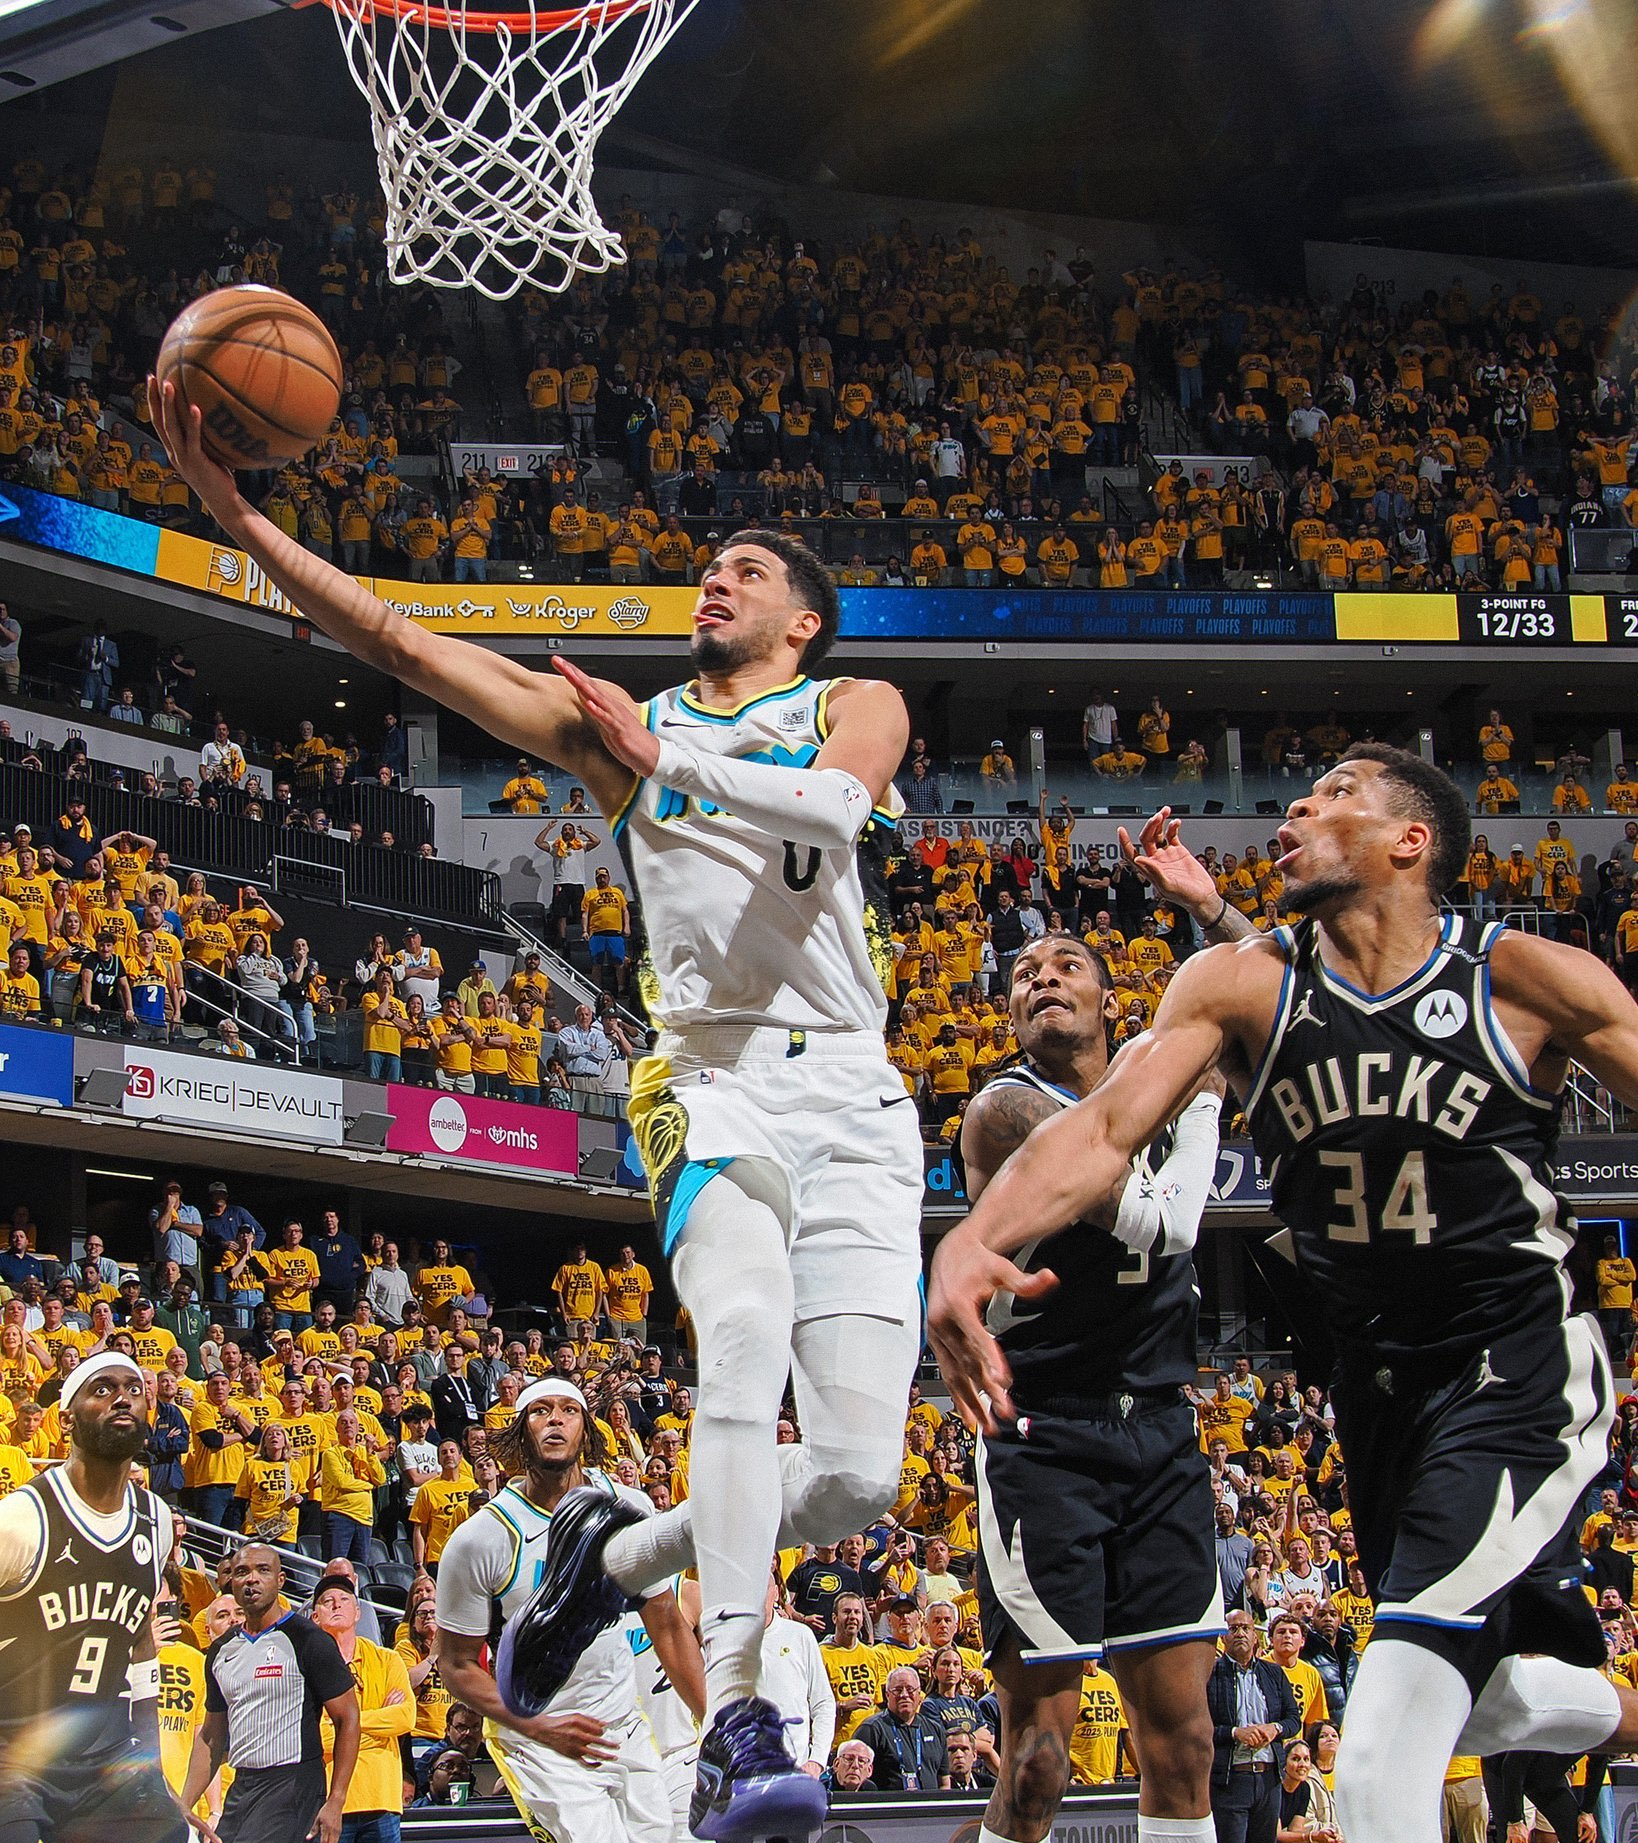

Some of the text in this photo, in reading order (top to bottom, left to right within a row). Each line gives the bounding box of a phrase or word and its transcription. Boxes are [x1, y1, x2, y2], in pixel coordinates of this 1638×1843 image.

[462, 452, 486, 471] 211
[501, 457, 517, 468] EXIT
[1579, 511, 1598, 524] 77
[384, 599, 455, 618] KeyBank
[1167, 599, 1210, 615] PLAYOFFS
[1223, 599, 1267, 615] PLAYOFFS
[1481, 599, 1547, 610] 3-POINT FG
[534, 595, 597, 629] Kroger
[608, 599, 650, 626] Starry
[1195, 619, 1240, 634] PLAYOFFS
[1252, 619, 1296, 634] PLAYOFFS
[1476, 612, 1555, 638] 12/33
[66, 727, 82, 740] 107
[114, 861, 138, 869] CERS
[20, 886, 41, 894] YES
[18, 894, 44, 903] CERS
[104, 917, 124, 926] YES
[101, 925, 127, 936] CERS
[206, 929, 224, 938] YES
[8, 986, 26, 997] YES
[147, 985, 158, 1002] 7
[520, 1036, 537, 1044] YES
[1272, 1053, 1492, 1142] BUCKS
[507, 1127, 538, 1150] mhs
[1574, 1161, 1638, 1183] Sports
[1319, 1150, 1437, 1245] 34
[286, 1259, 306, 1268] YES
[283, 1268, 309, 1277] CERS
[432, 1274, 453, 1282] YES
[572, 1273, 590, 1281] YES
[430, 1282, 457, 1290] CERS
[570, 1281, 593, 1289] CERS
[621, 1277, 638, 1285] YES
[617, 1285, 642, 1293] CERS
[136, 1339, 157, 1347] YES
[321, 1340, 337, 1349] YES
[405, 1340, 424, 1348] YES
[353, 1395, 372, 1404] YES
[288, 1425, 312, 1435] YES
[263, 1469, 286, 1480] YES
[445, 1492, 470, 1503] YES
[38, 1581, 151, 1635] BUCKS
[1350, 1605, 1371, 1616] YES
[68, 1637, 109, 1694] 9
[254, 1666, 284, 1677] Emirates
[840, 1663, 870, 1680] YES
[1082, 1690, 1116, 1705] YES
[1080, 1706, 1120, 1723] CERS
[1080, 1727, 1101, 1737] 2025
